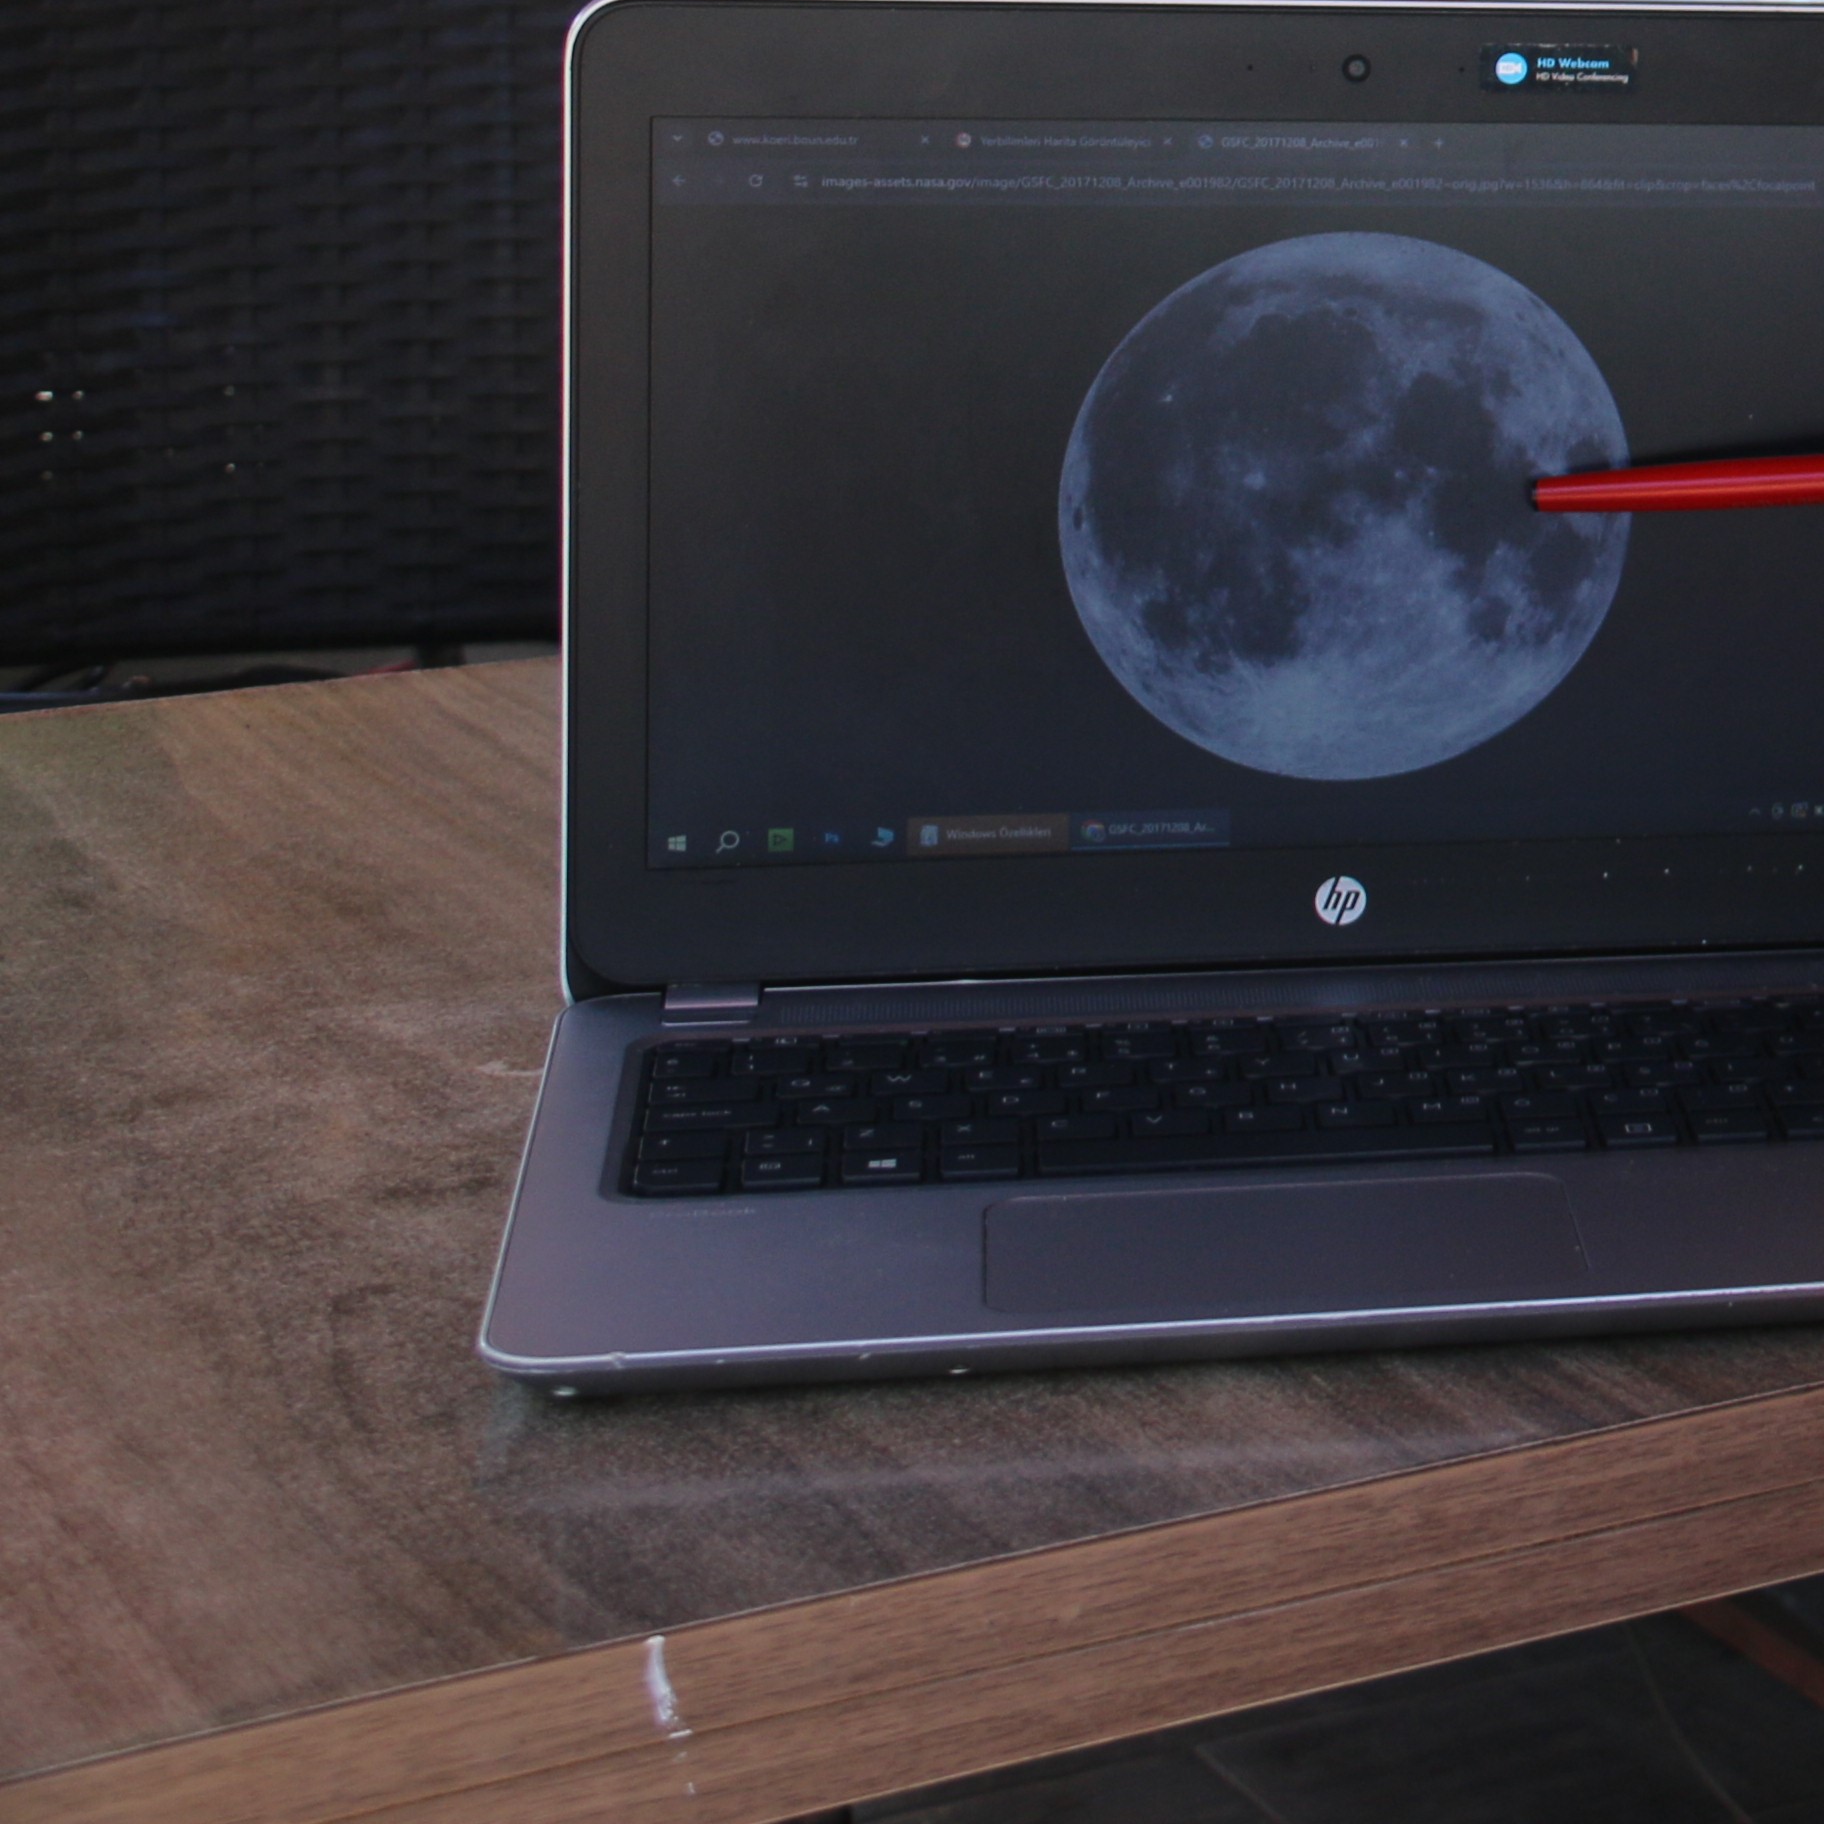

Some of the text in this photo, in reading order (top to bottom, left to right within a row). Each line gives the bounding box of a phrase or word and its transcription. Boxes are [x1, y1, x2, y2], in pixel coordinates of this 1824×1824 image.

[1537, 57, 1610, 69] HD Webcam
[1536, 72, 1629, 84] HD Video Conferencing
[945, 823, 1052, 840] Windows Özellikleri
[1321, 875, 1362, 926] hp
